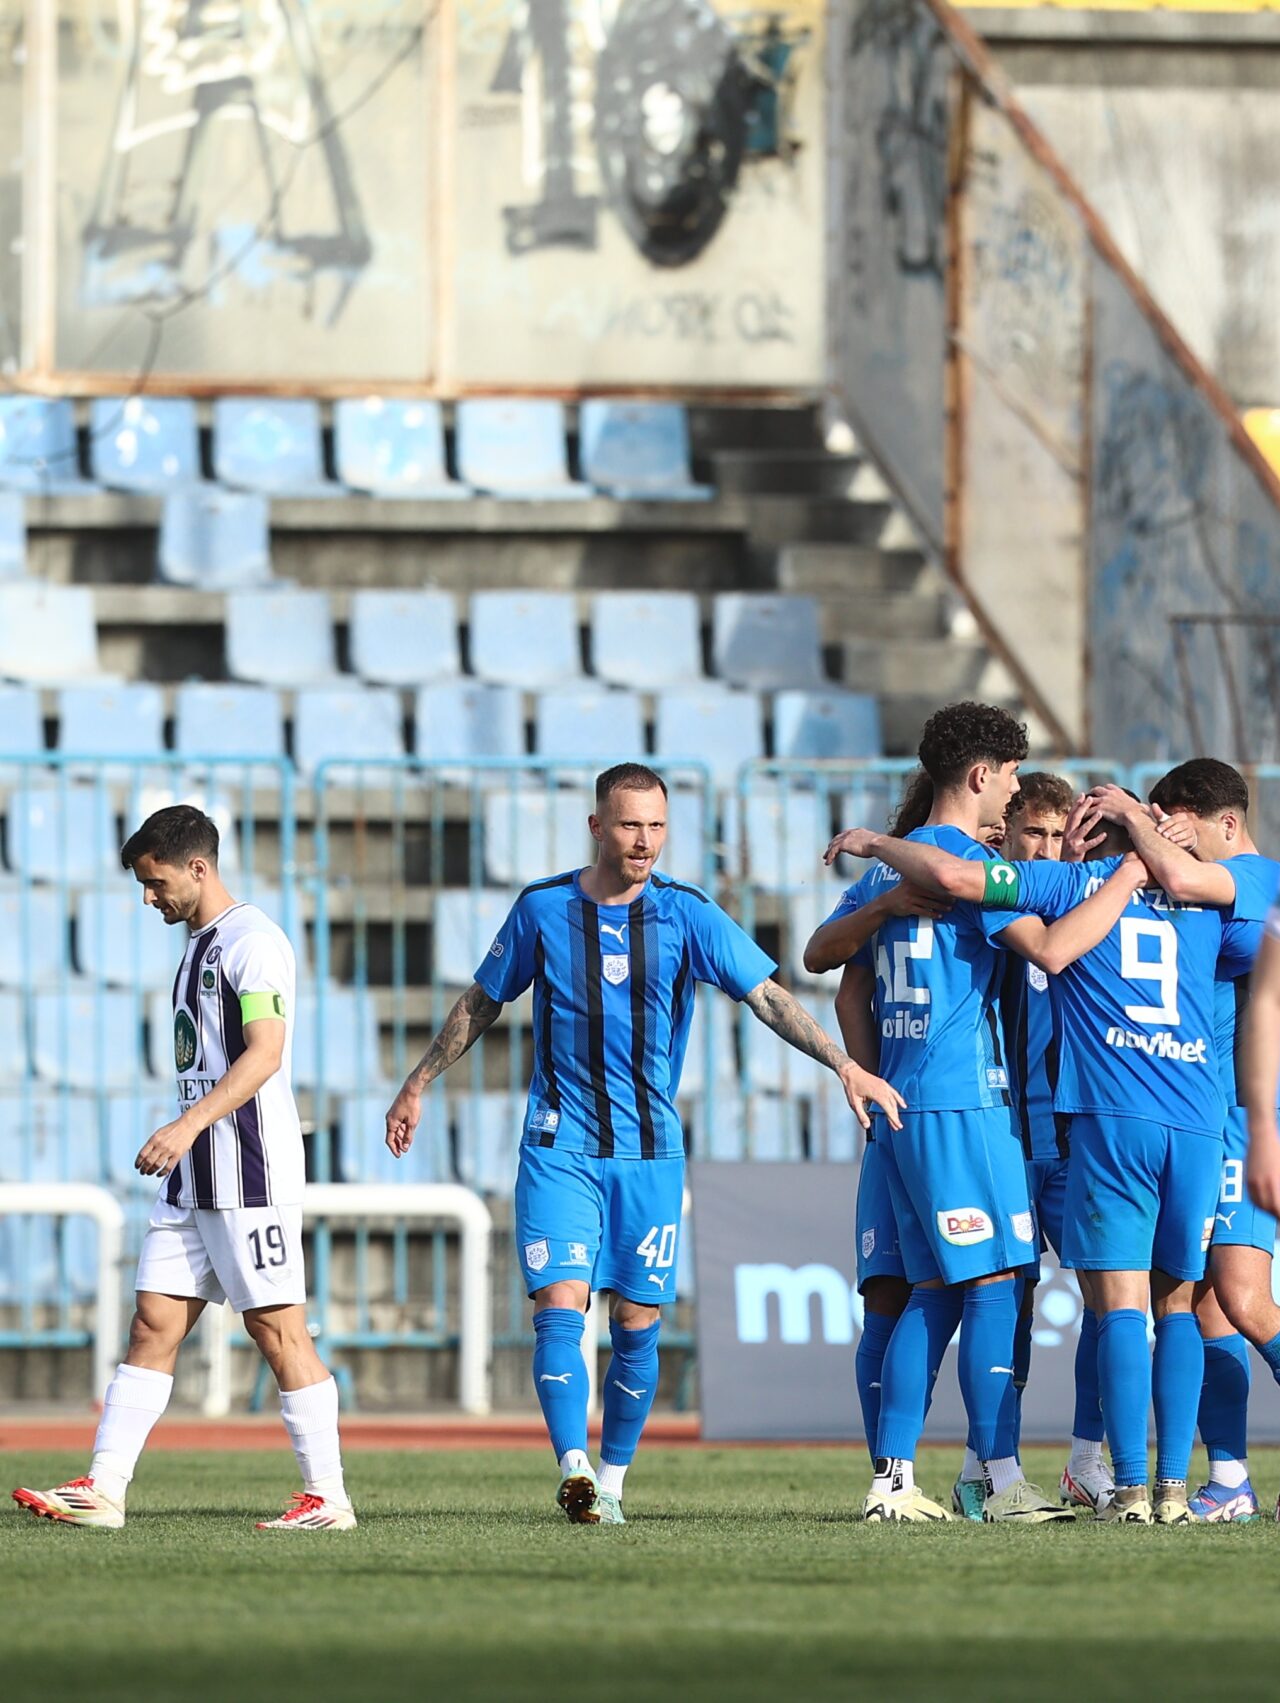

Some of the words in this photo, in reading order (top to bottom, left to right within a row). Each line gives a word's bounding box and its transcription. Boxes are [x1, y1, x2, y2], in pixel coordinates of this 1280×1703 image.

[1119, 917, 1182, 1027] 9
[1105, 1026, 1208, 1064] novibet
[636, 1222, 677, 1269] 40
[946, 1214, 985, 1233] Dole
[248, 1224, 287, 1271] 19
